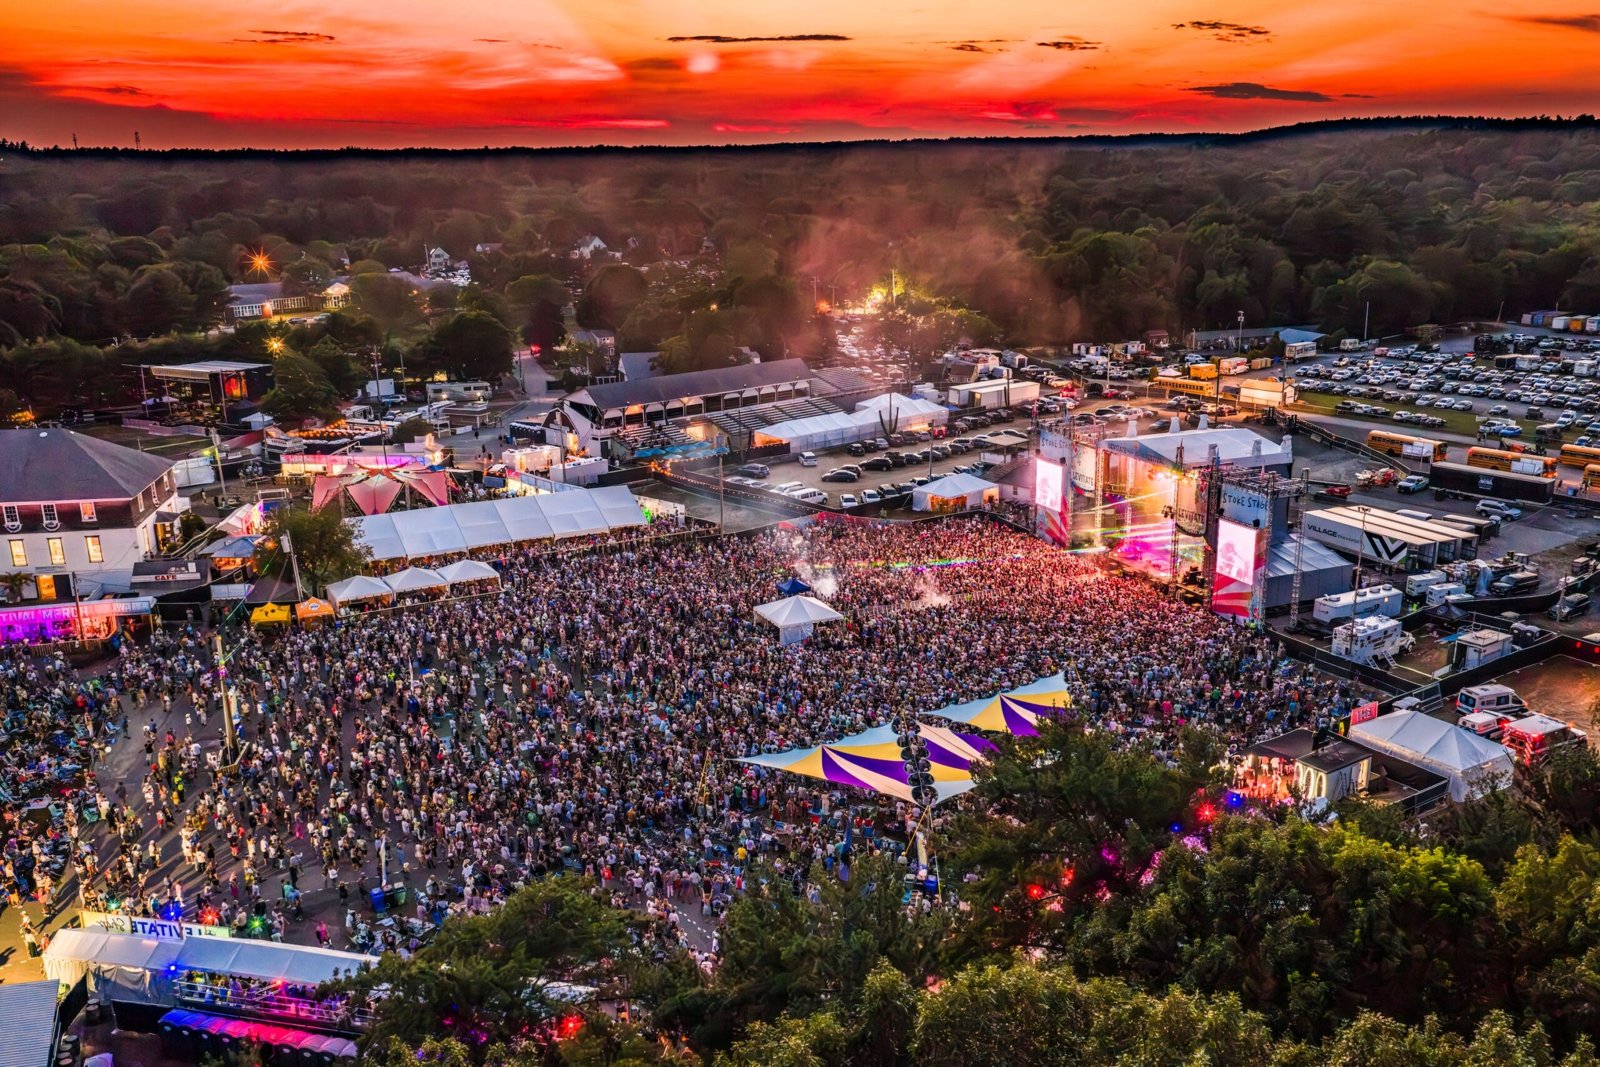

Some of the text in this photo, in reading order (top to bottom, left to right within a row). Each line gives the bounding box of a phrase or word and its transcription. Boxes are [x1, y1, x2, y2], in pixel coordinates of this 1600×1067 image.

[1072, 471, 1094, 487] LEVITATE
[1222, 492, 1246, 507] STOKE
[1178, 507, 1205, 525] LEVITATE
[1307, 523, 1338, 538] VILLAGE
[41, 605, 89, 619] MERCH
